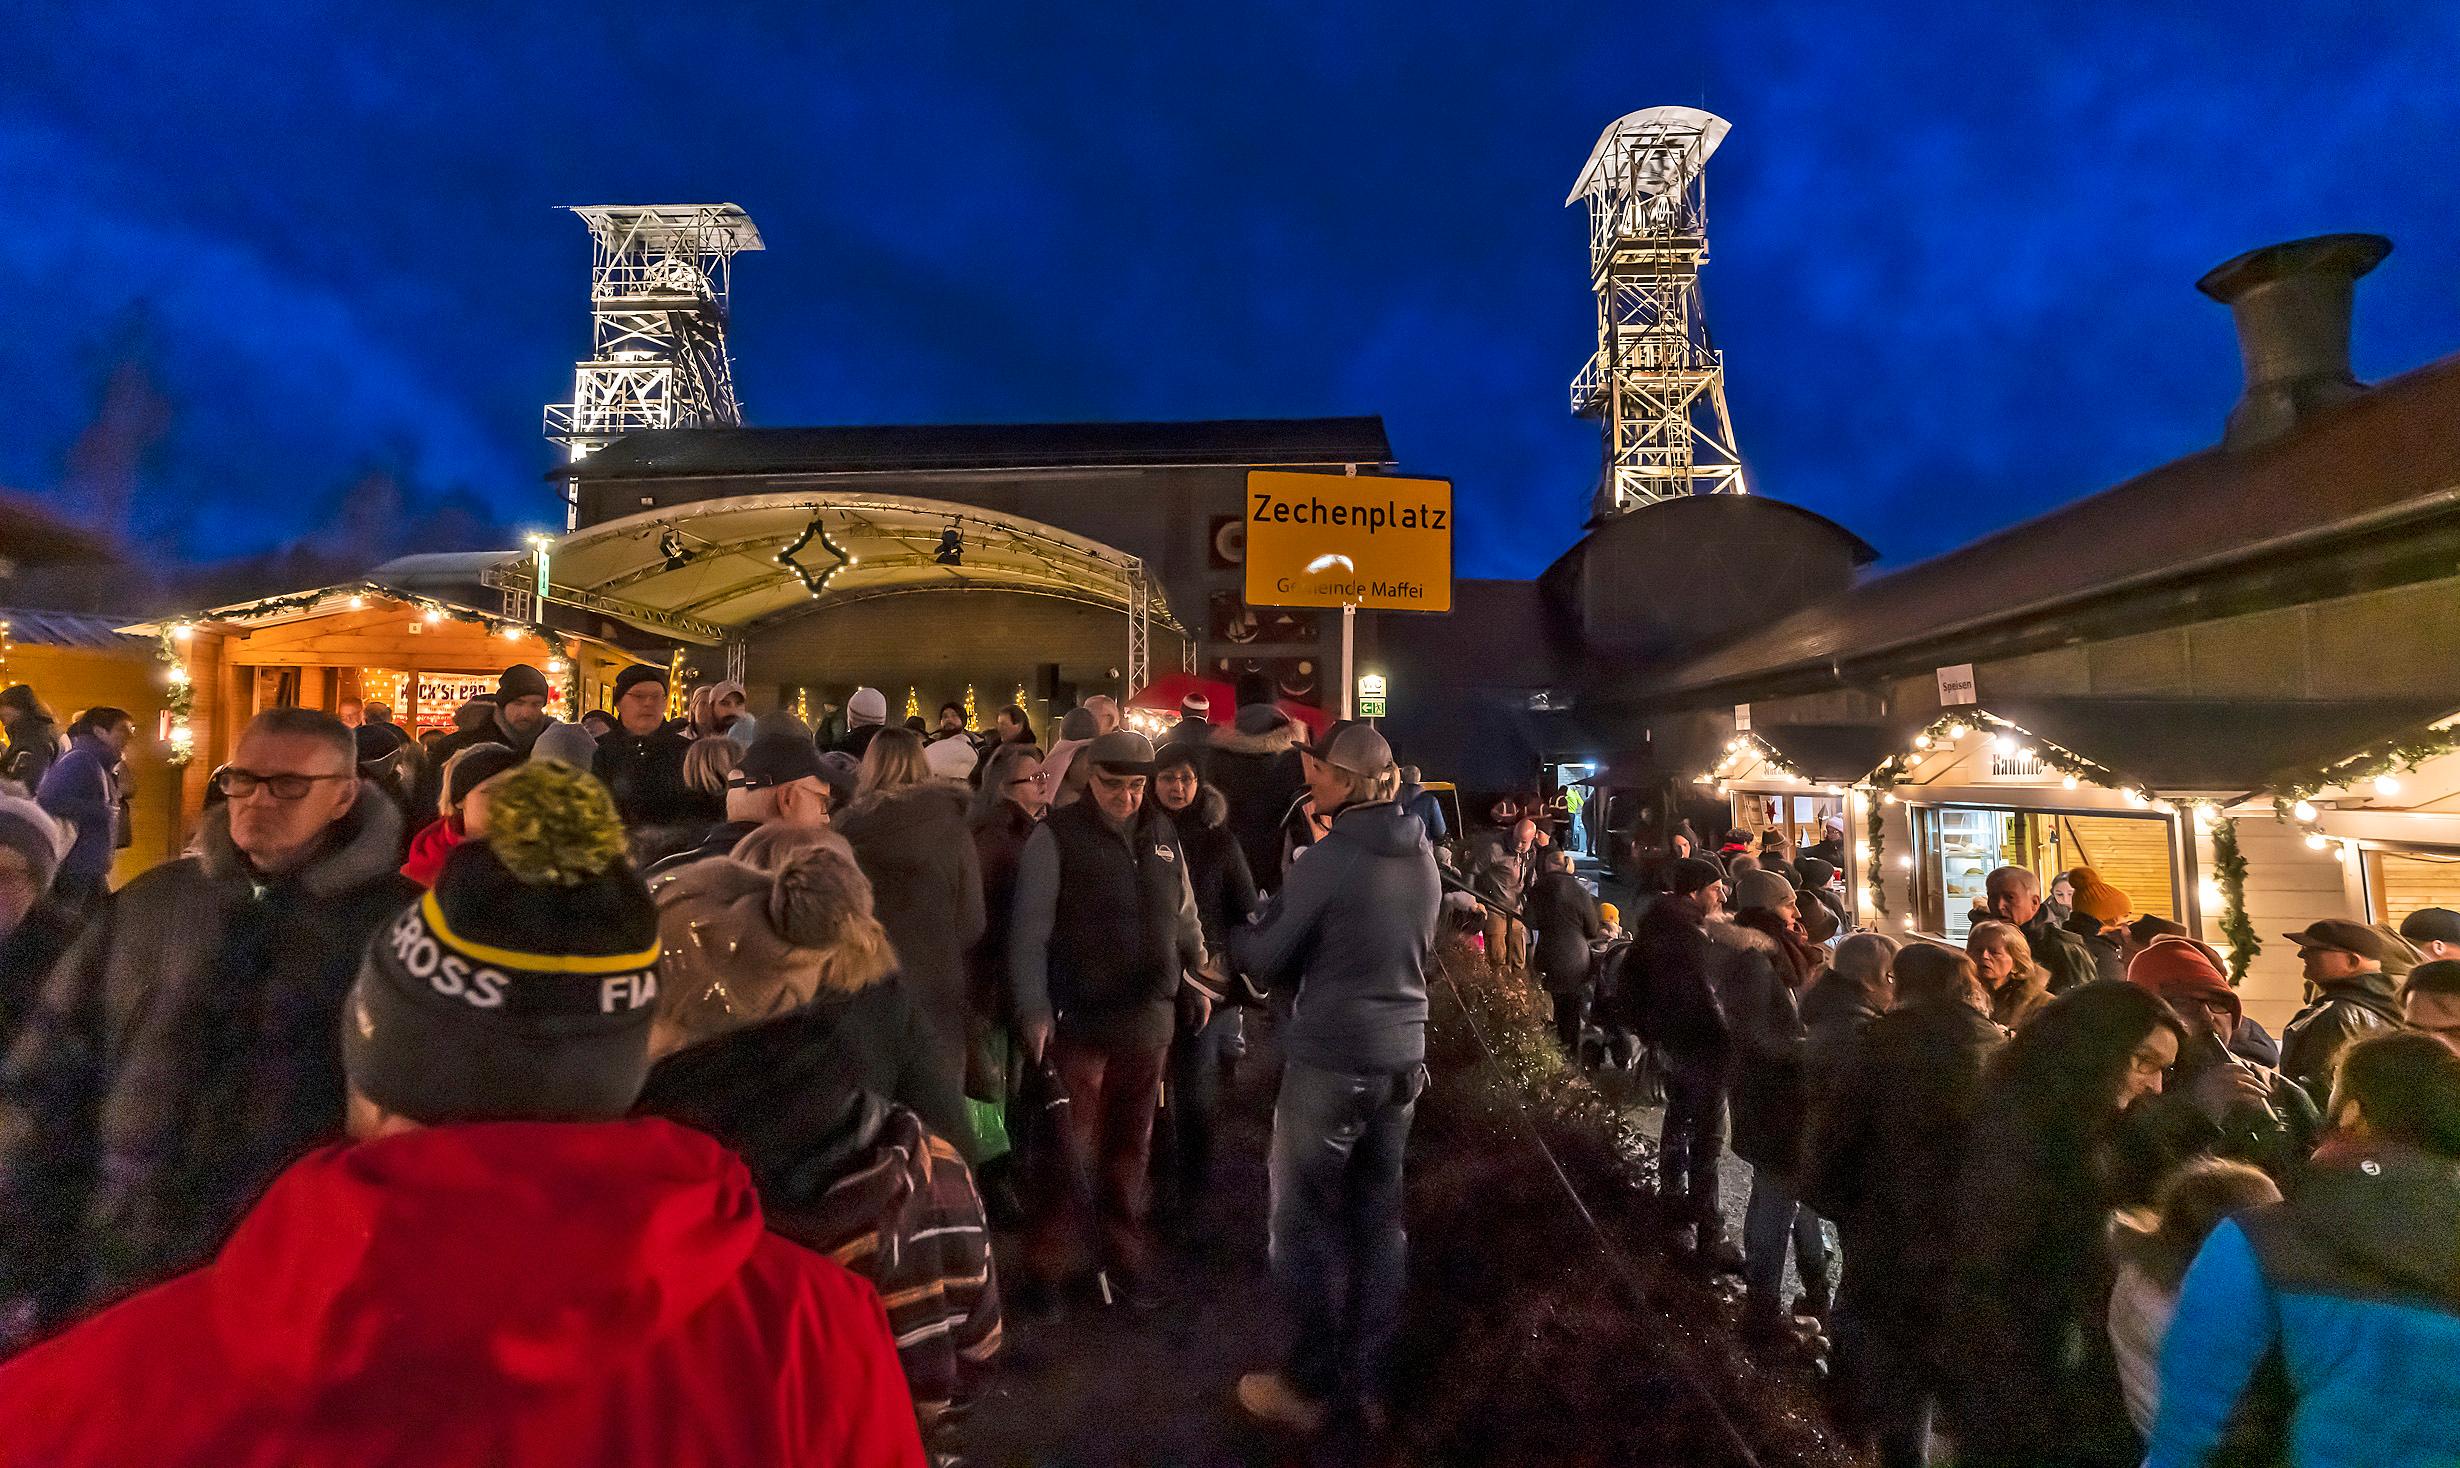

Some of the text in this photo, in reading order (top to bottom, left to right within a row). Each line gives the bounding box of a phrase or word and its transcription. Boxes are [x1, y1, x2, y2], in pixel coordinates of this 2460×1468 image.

[1253, 494, 1446, 534] Zechenplatz
[1277, 577, 1423, 599] Geeinde Maffei
[1943, 681, 1972, 693] Speisen
